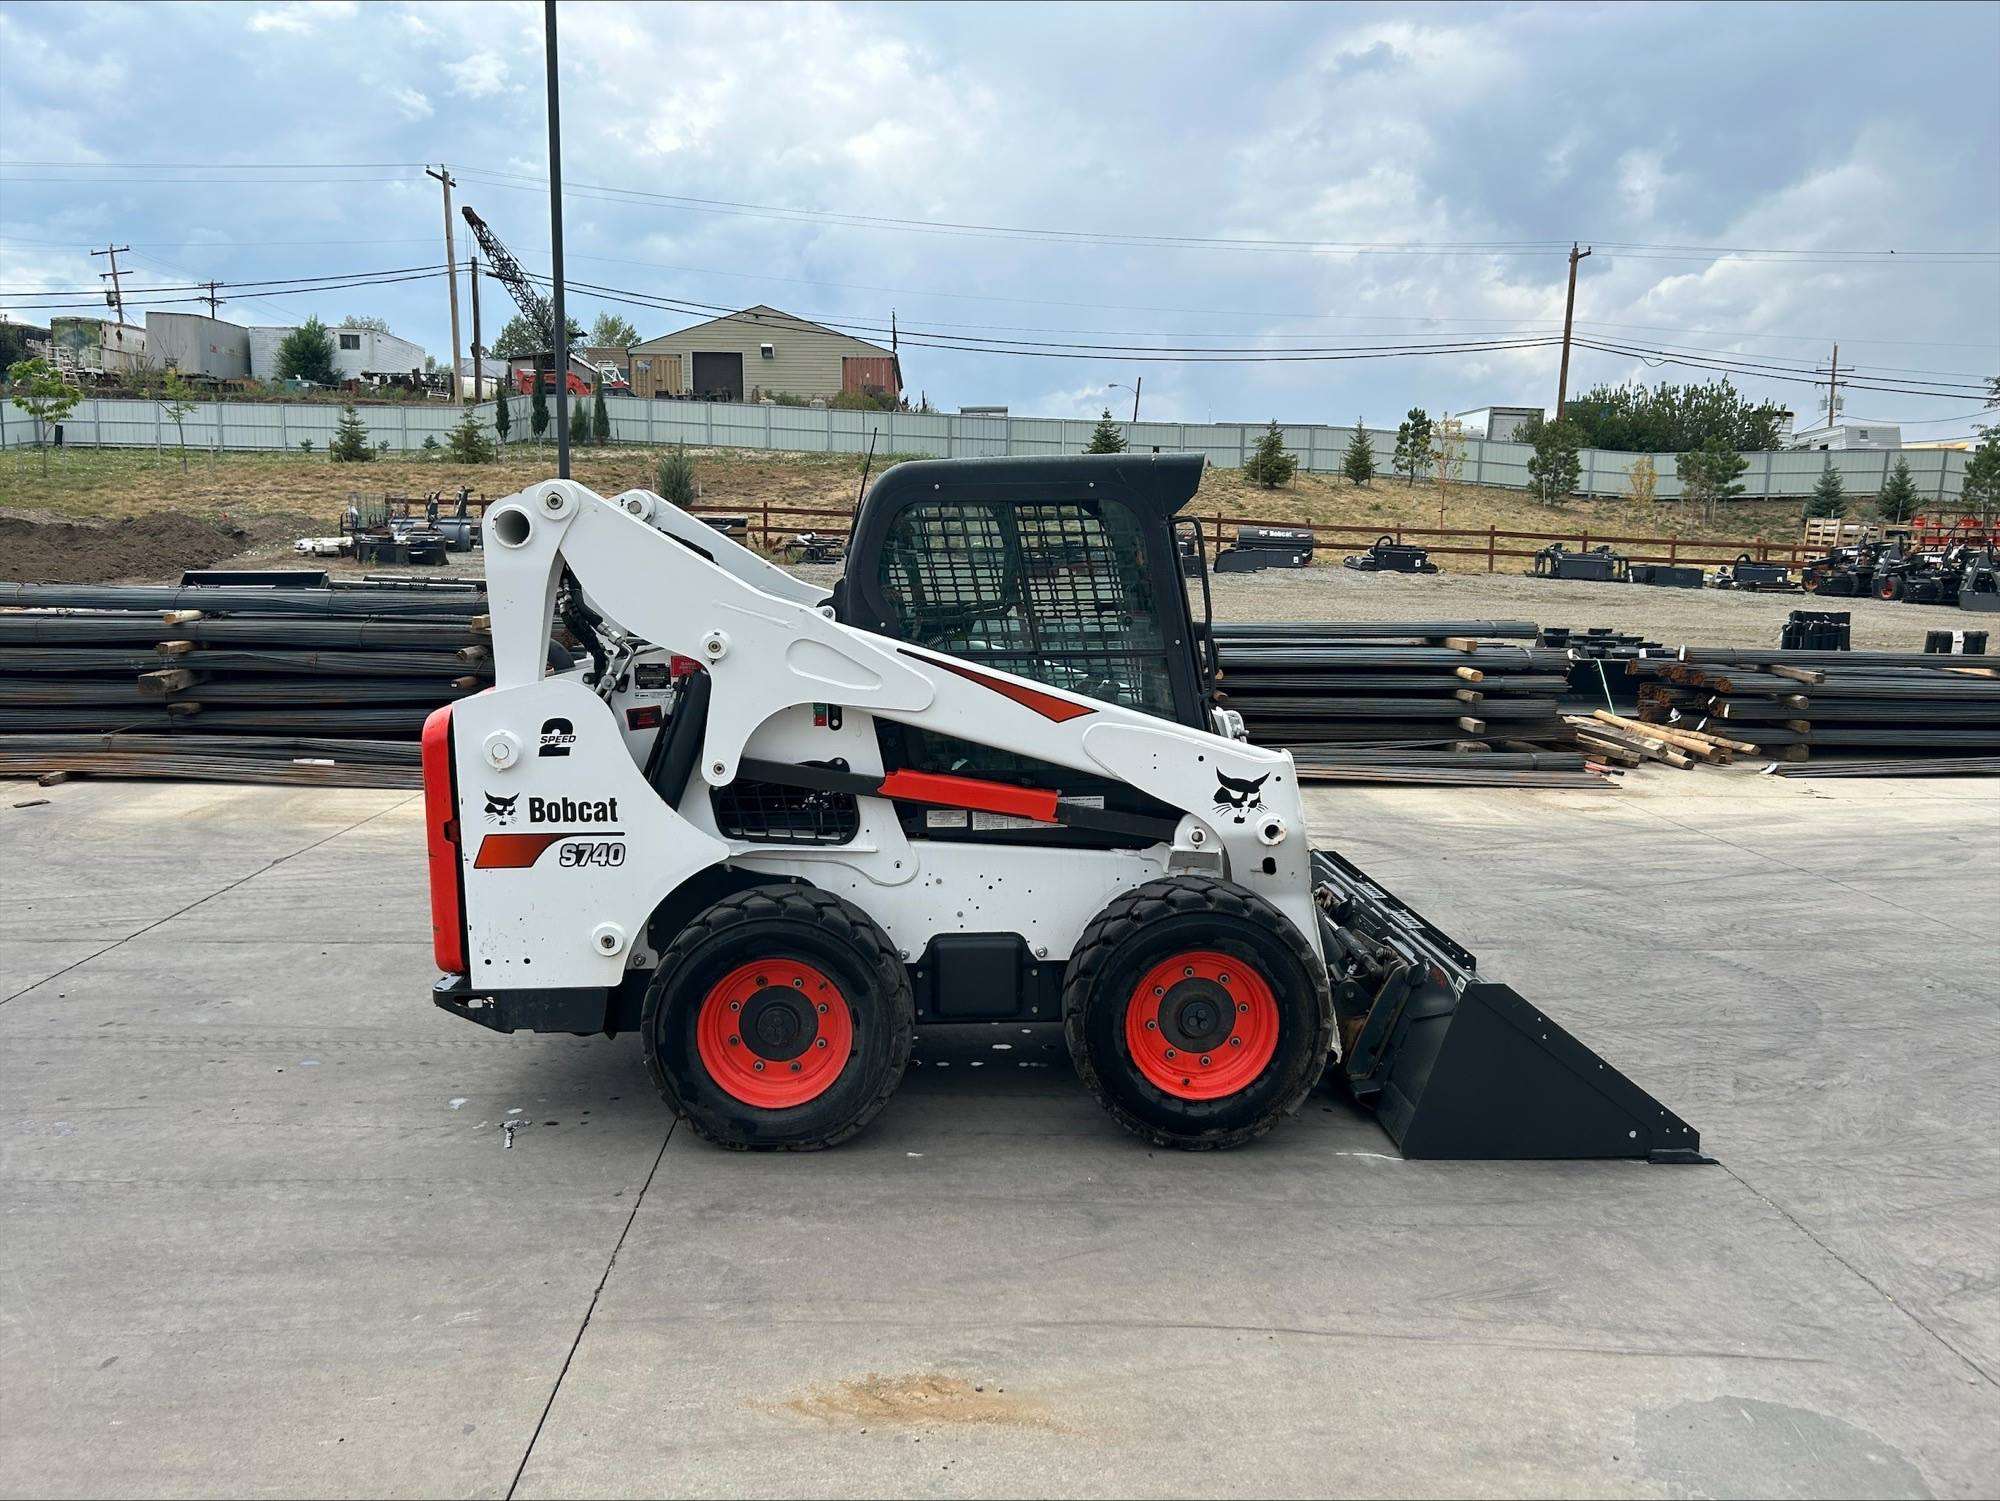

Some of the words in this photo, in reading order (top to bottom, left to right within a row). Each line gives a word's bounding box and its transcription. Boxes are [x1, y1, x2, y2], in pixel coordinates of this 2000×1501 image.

[1269, 530, 1293, 538] Bobcat
[538, 717, 574, 757] 2
[539, 735, 577, 744] SPEED
[528, 796, 619, 823] Bobcat
[559, 842, 626, 868] S740
